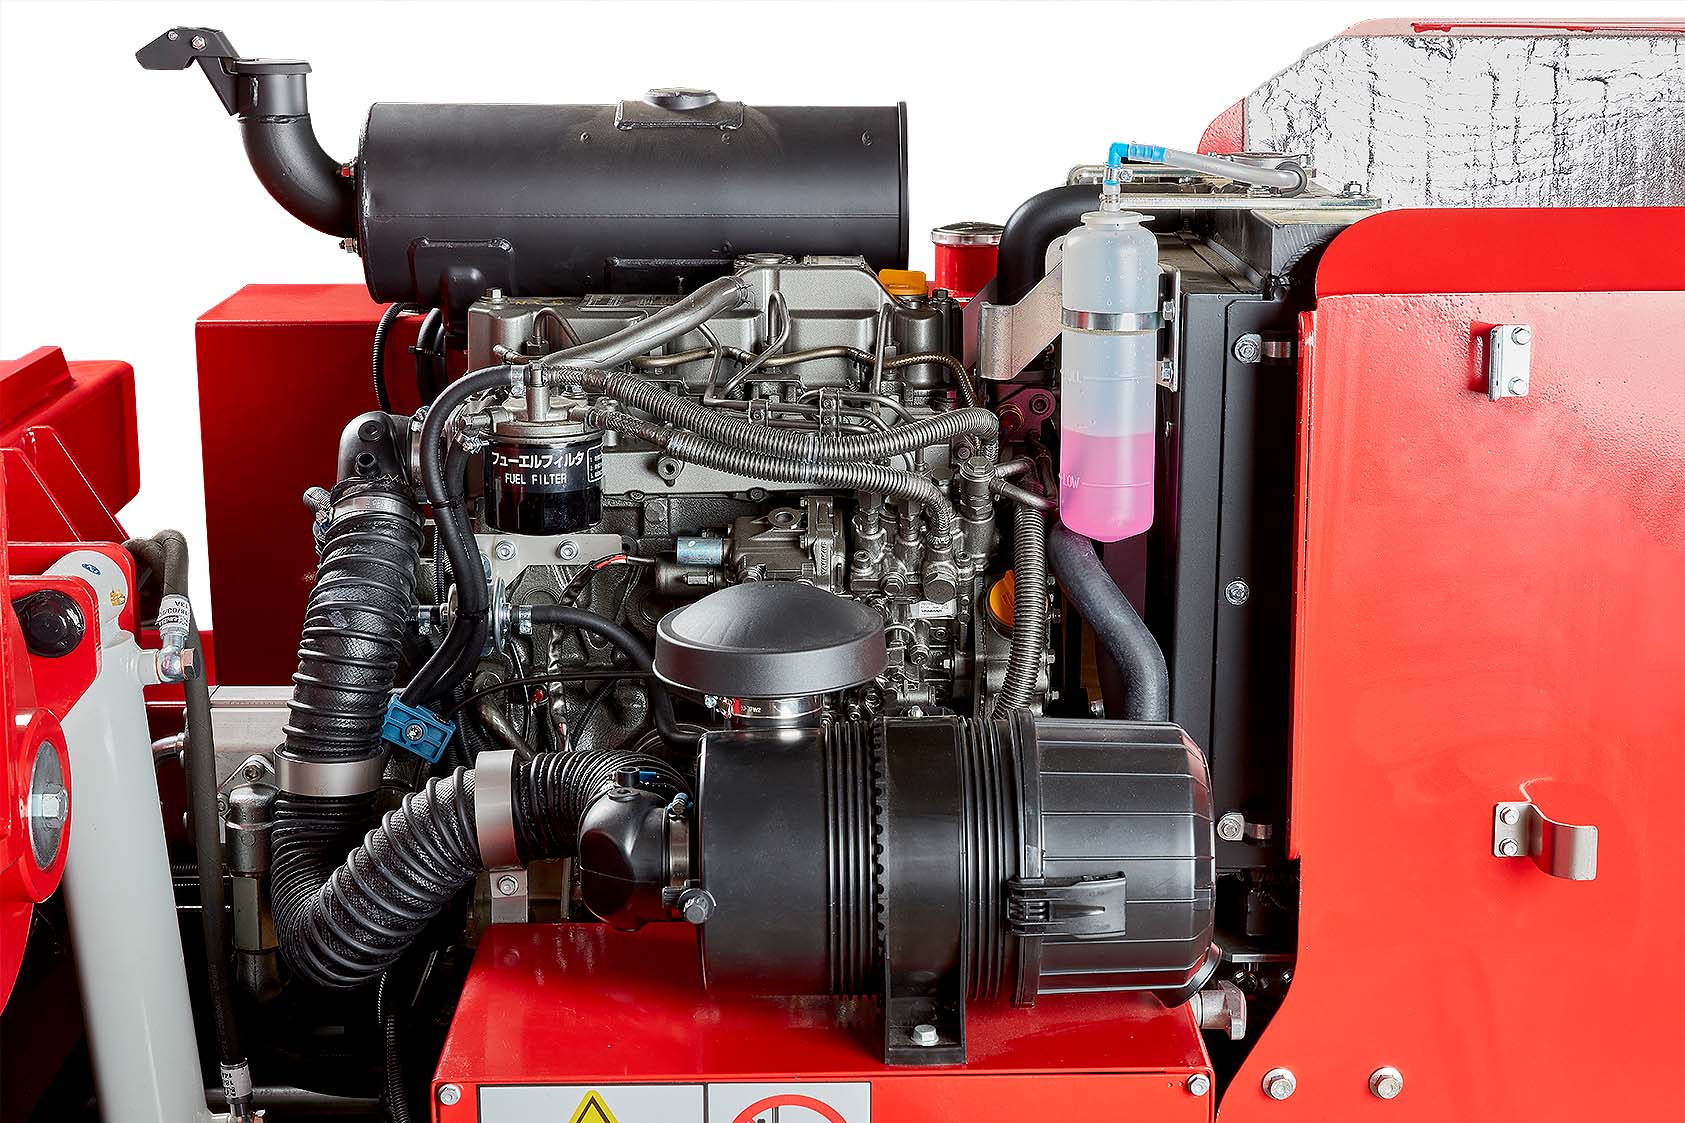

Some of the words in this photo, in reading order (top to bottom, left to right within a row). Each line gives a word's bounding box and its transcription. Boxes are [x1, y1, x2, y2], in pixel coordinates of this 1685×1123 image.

[491, 450, 585, 469] フューエルフィルタ
[505, 473, 526, 485] FUEL
[531, 473, 567, 485] FILTER
[1063, 473, 1081, 489] LOW
